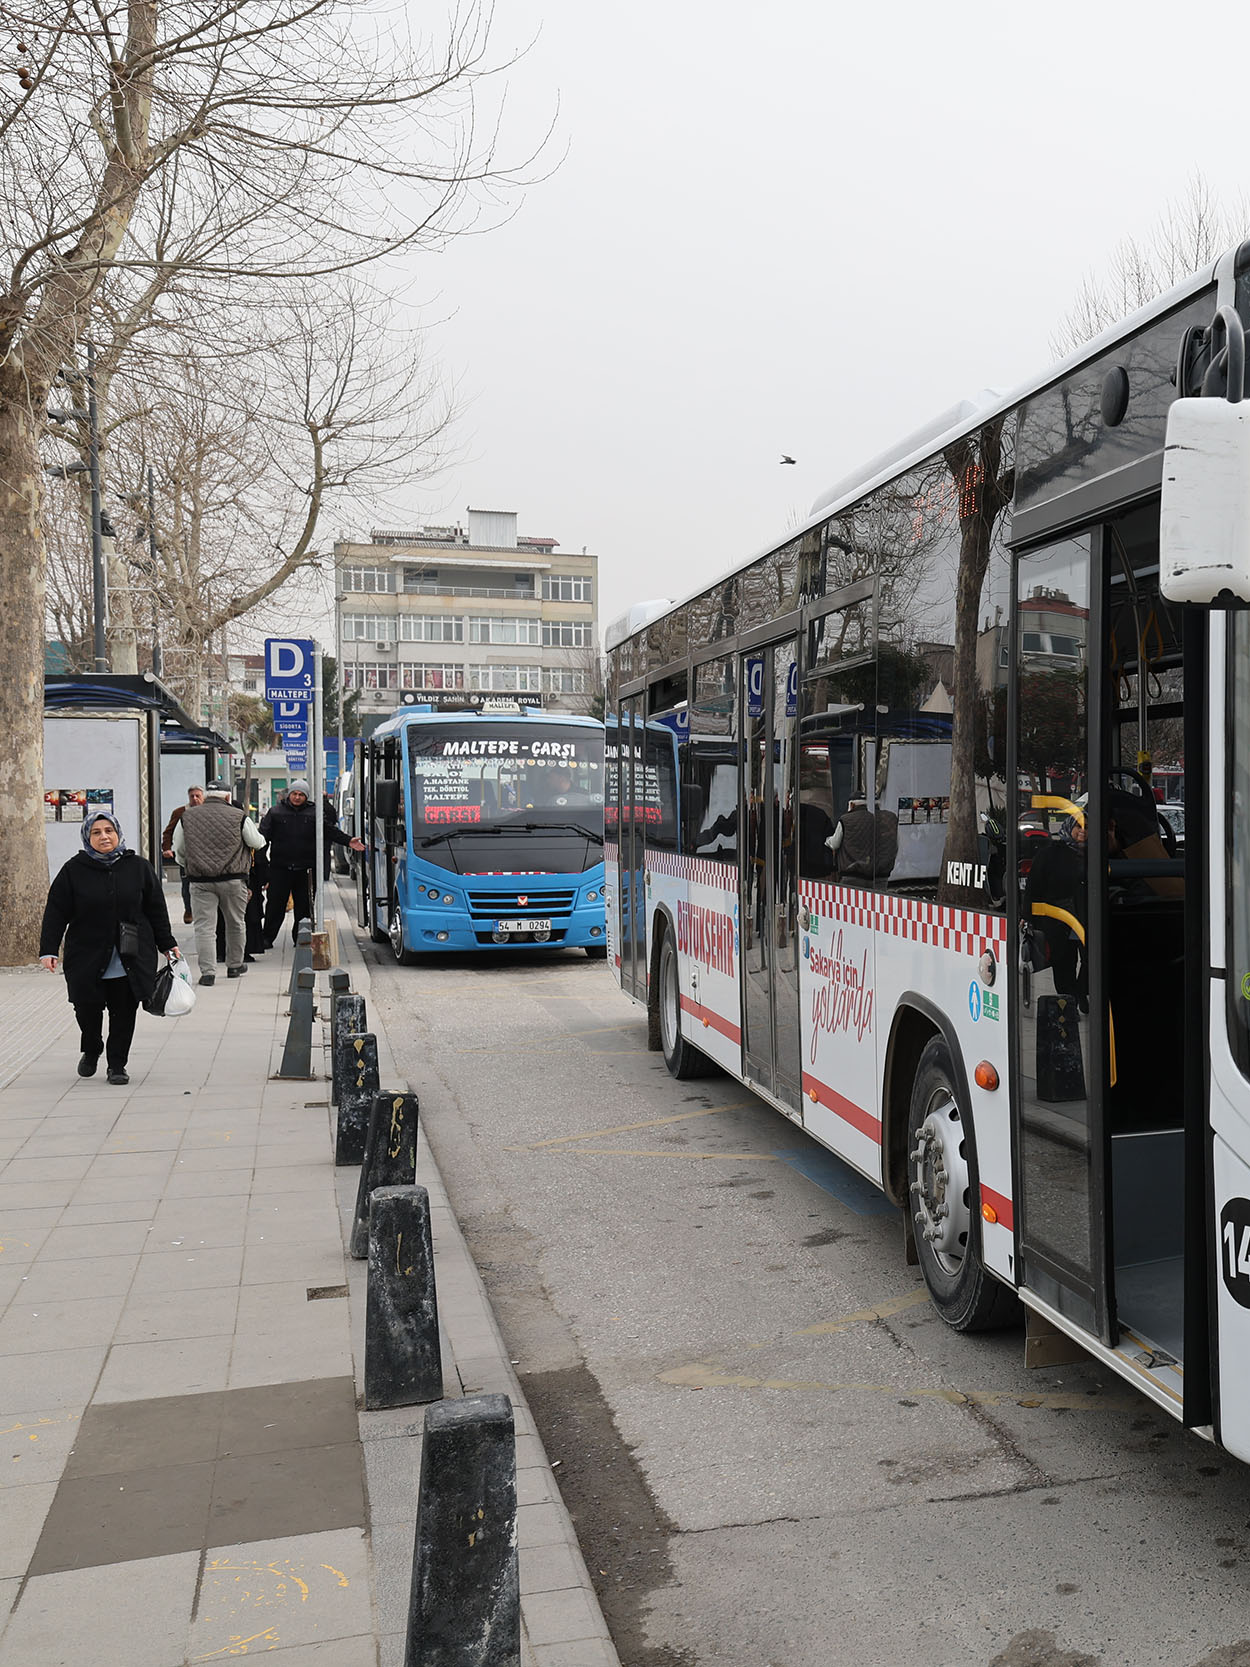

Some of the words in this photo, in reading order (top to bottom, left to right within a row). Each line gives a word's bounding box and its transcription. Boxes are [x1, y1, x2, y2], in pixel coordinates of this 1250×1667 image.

[271, 642, 304, 677] D
[304, 673, 311, 686] 3
[271, 690, 308, 698] MALTEPE
[417, 694, 439, 703] YILDIZ
[443, 741, 518, 756] MALTEPE
[531, 742, 575, 759] ÇARŞI
[946, 861, 972, 887] KENT
[974, 864, 987, 889] LF
[499, 921, 509, 931] 54
[517, 922, 522, 930] M
[529, 920, 550, 930] 0294
[678, 900, 734, 979] BÜYÜKŞEHİR
[810, 946, 841, 986] Sakarya
[843, 956, 858, 990] için
